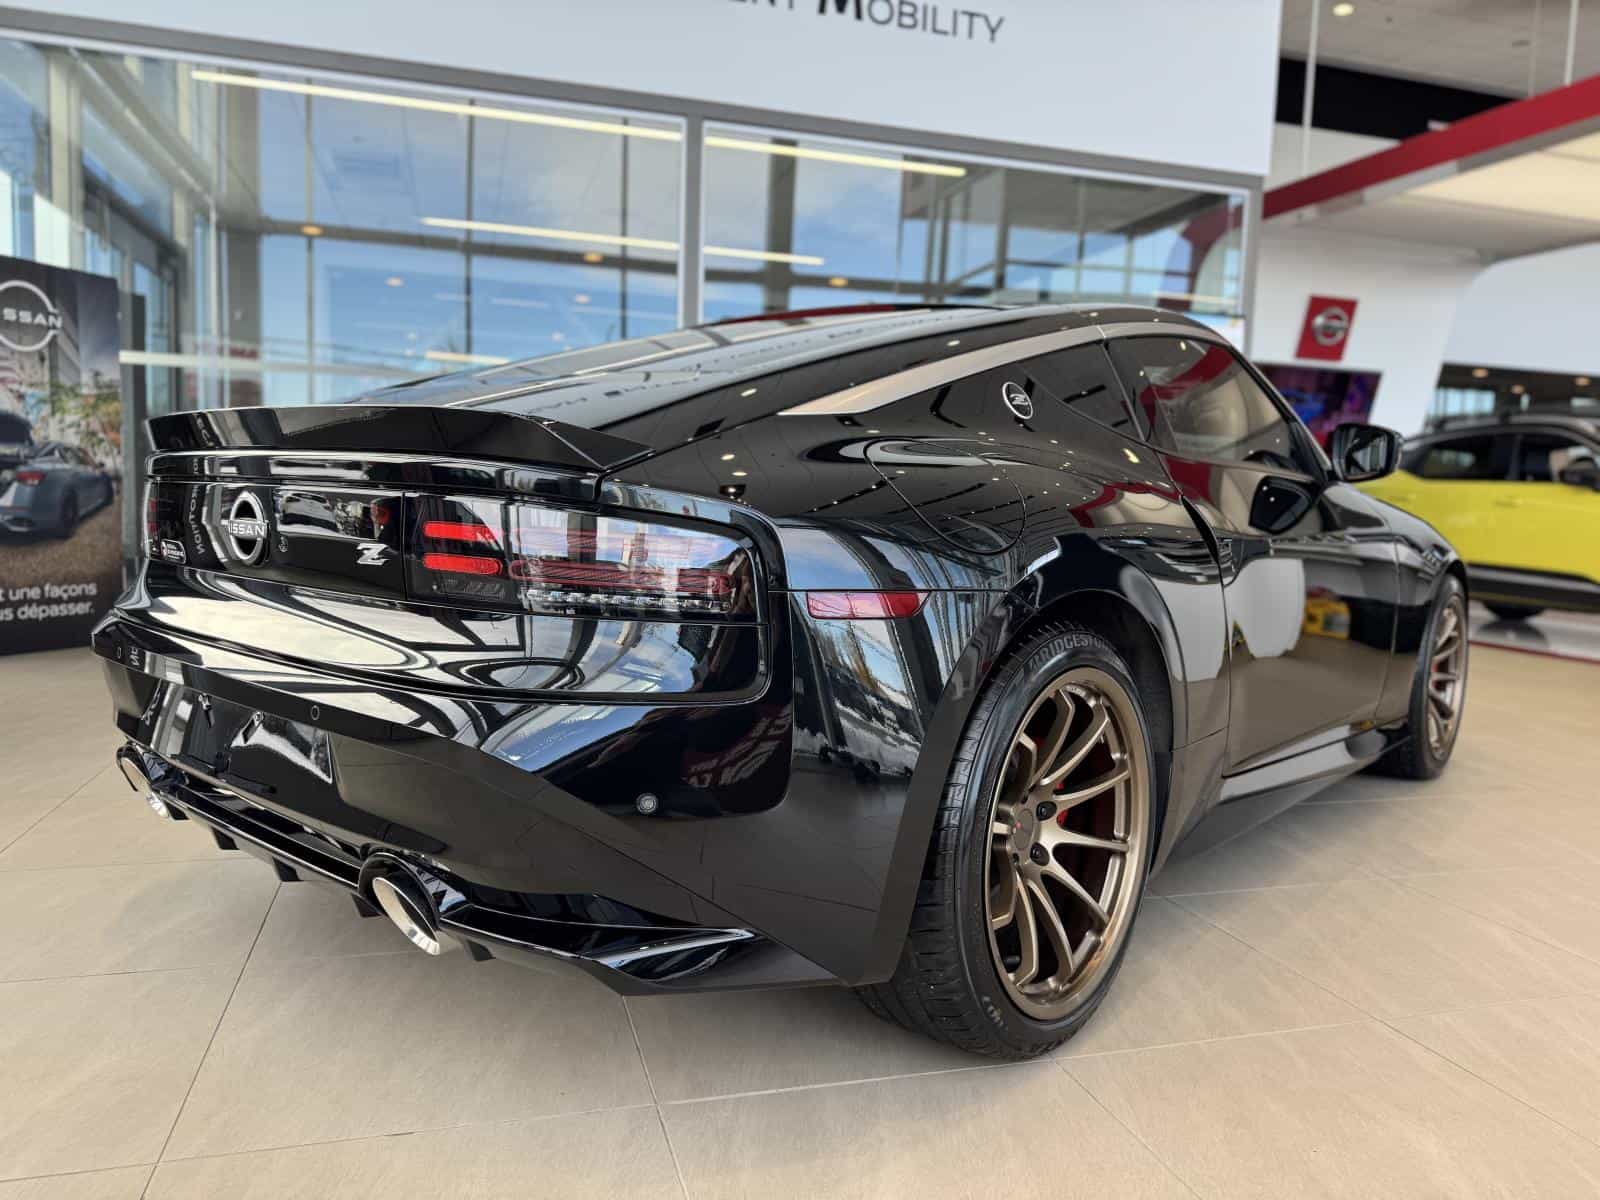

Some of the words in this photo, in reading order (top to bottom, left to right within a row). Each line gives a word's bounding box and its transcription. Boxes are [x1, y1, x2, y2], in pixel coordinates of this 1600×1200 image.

[229, 522, 264, 537] ISSAN
[357, 542, 391, 567] Z
[9, 587, 41, 600] une
[44, 583, 97, 600] façons
[17, 602, 95, 621] dépasser.
